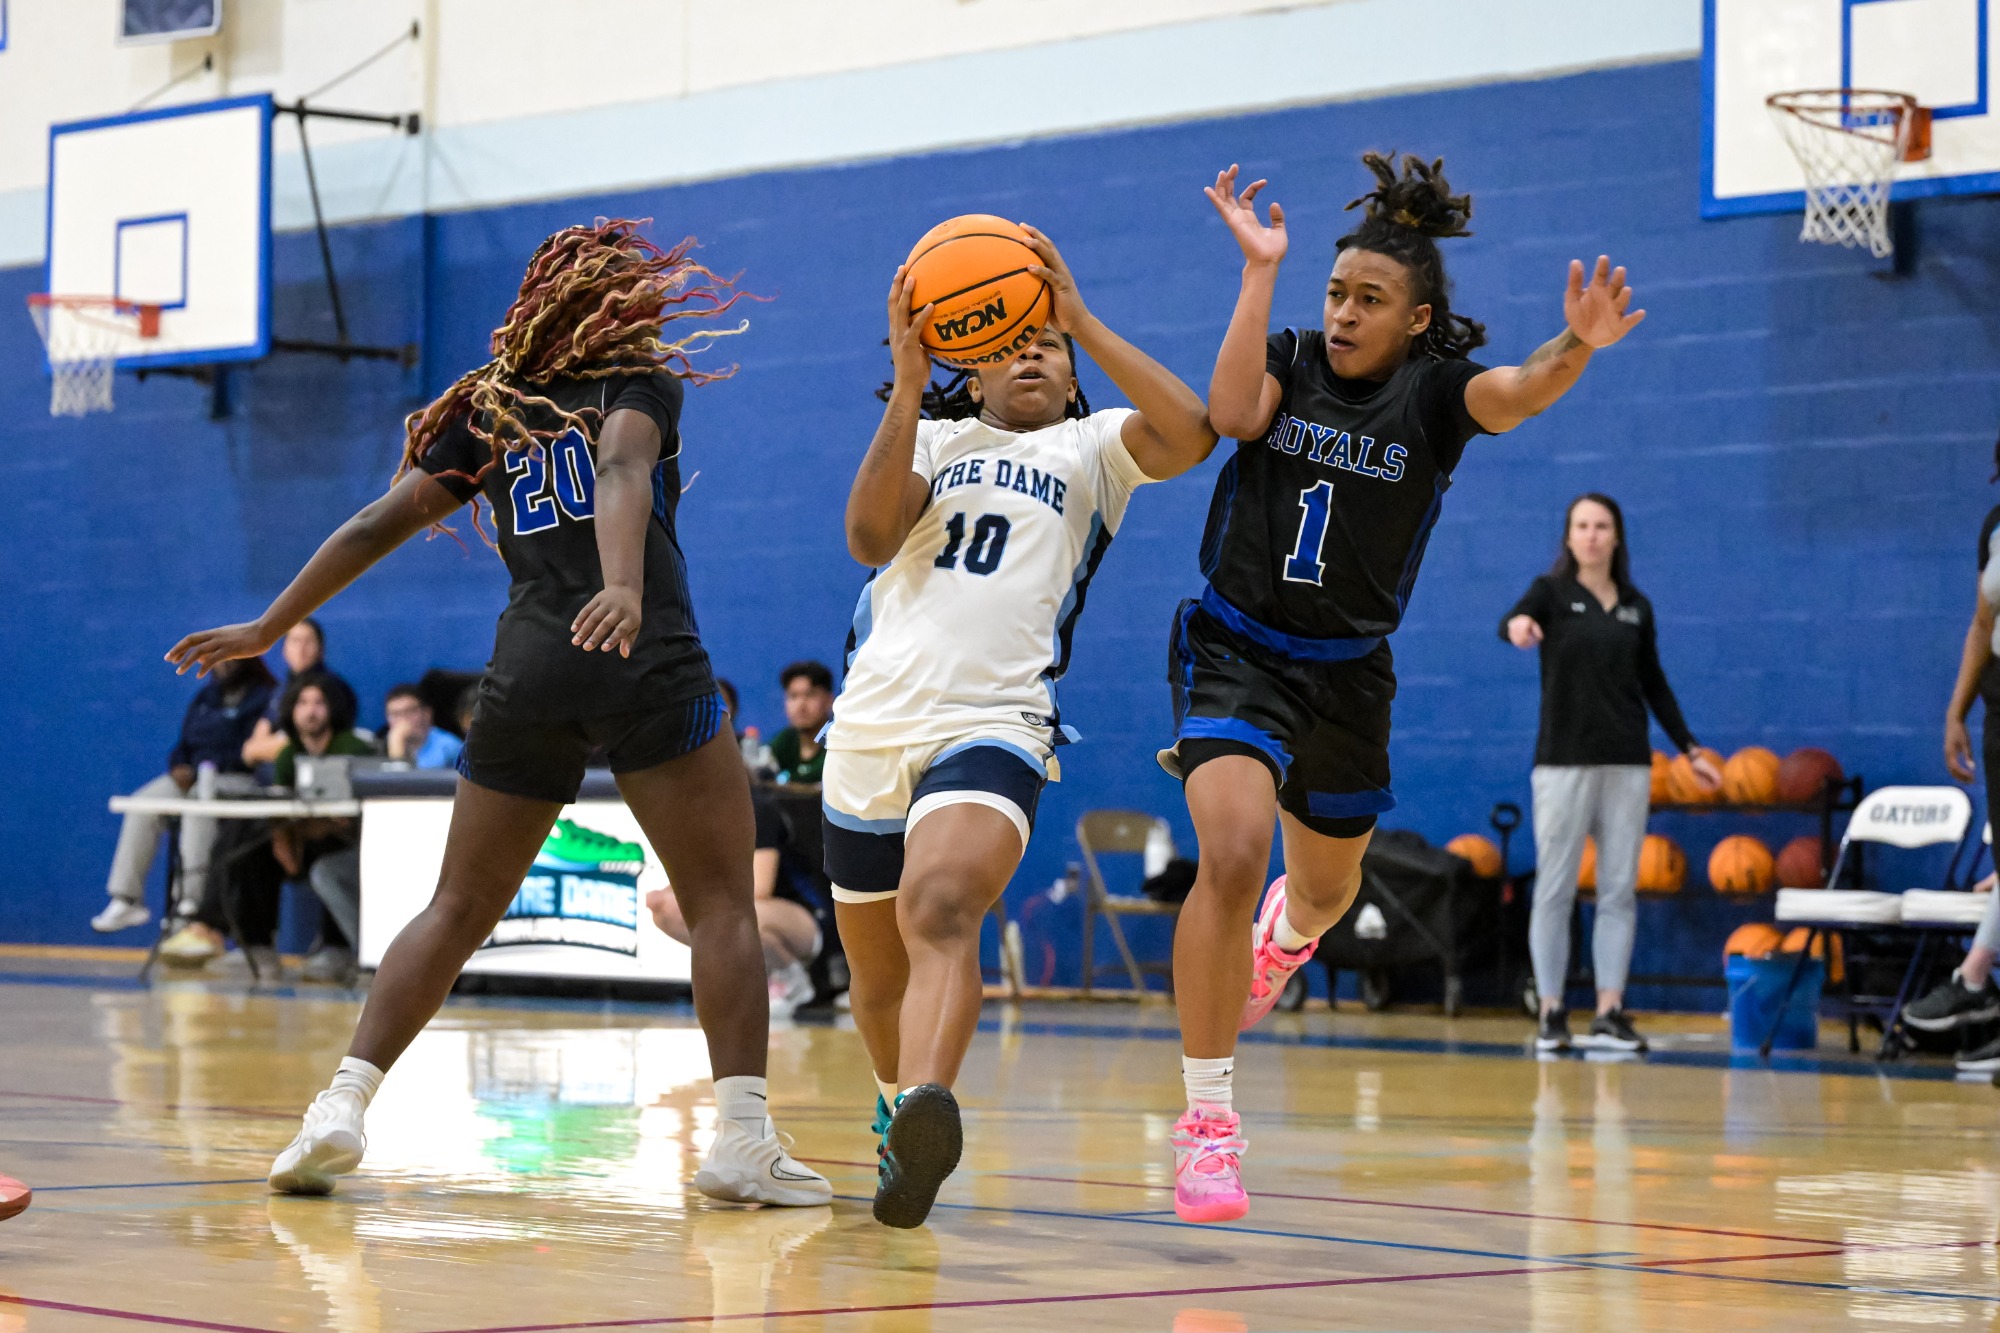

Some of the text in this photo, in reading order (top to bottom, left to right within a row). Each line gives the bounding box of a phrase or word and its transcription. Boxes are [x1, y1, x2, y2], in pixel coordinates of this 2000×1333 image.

[933, 297, 1008, 342] NCAA
[503, 425, 596, 535] 20
[1267, 412, 1408, 482] ROYALS
[994, 459, 1067, 517] DAME
[934, 511, 1012, 577] 10
[1282, 479, 1335, 587] 1
[1869, 803, 1952, 824] GATORS
